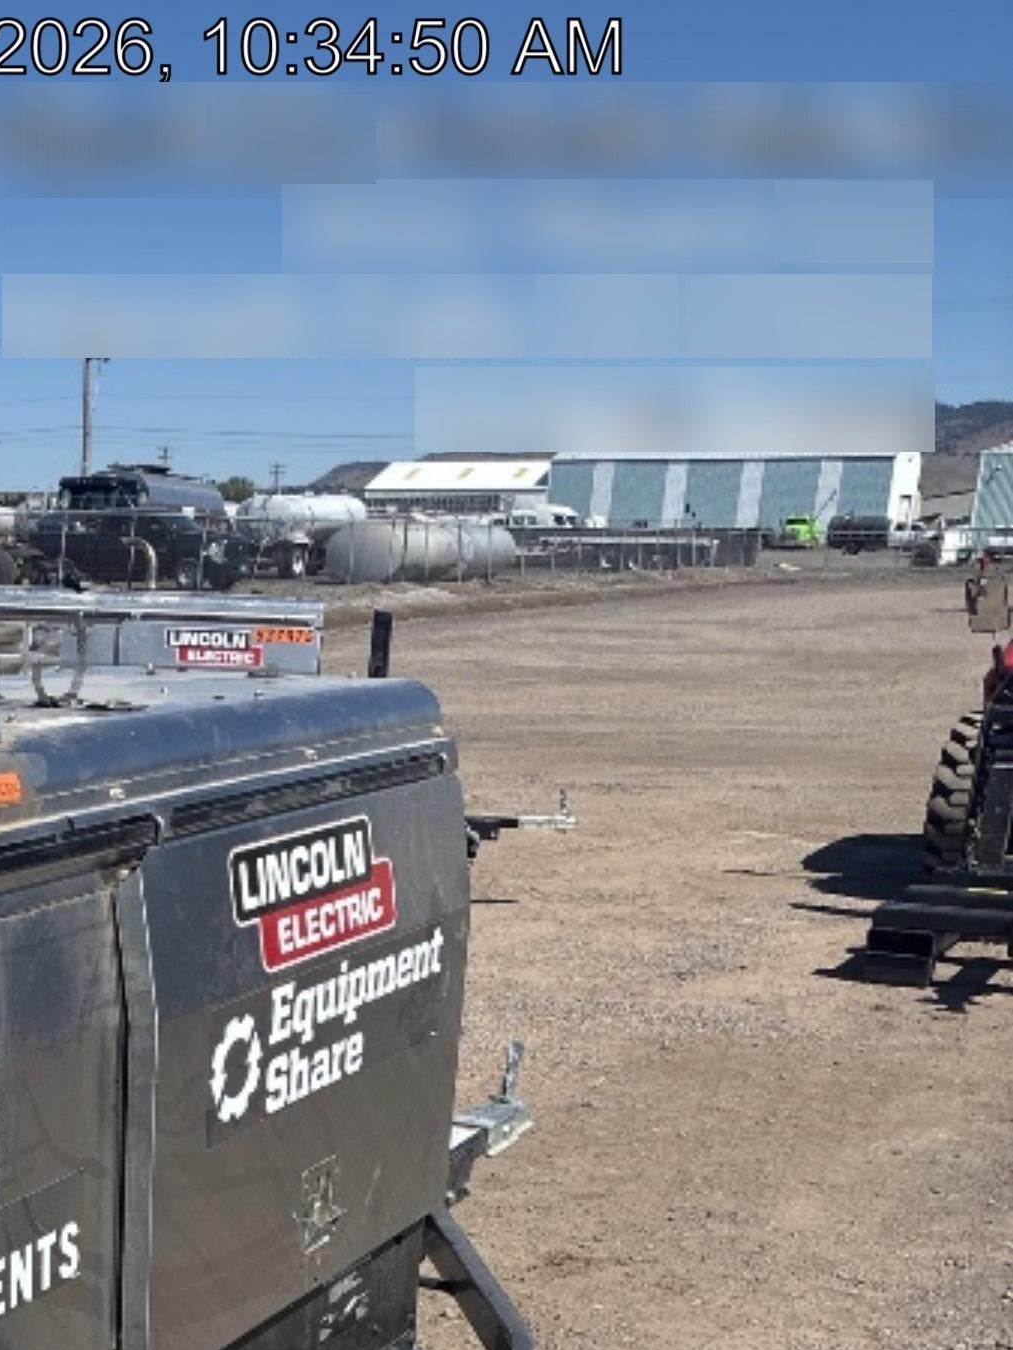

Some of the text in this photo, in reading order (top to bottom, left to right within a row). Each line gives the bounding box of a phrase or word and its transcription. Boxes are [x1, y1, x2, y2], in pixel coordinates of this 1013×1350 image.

[169, 631, 246, 648] LINCOLN
[188, 650, 255, 664] ELECTRIC
[238, 831, 367, 911] LINCOLN
[277, 887, 384, 955] ELECTRIC
[269, 927, 444, 1045] Equipment
[265, 1031, 364, 1114] Share
